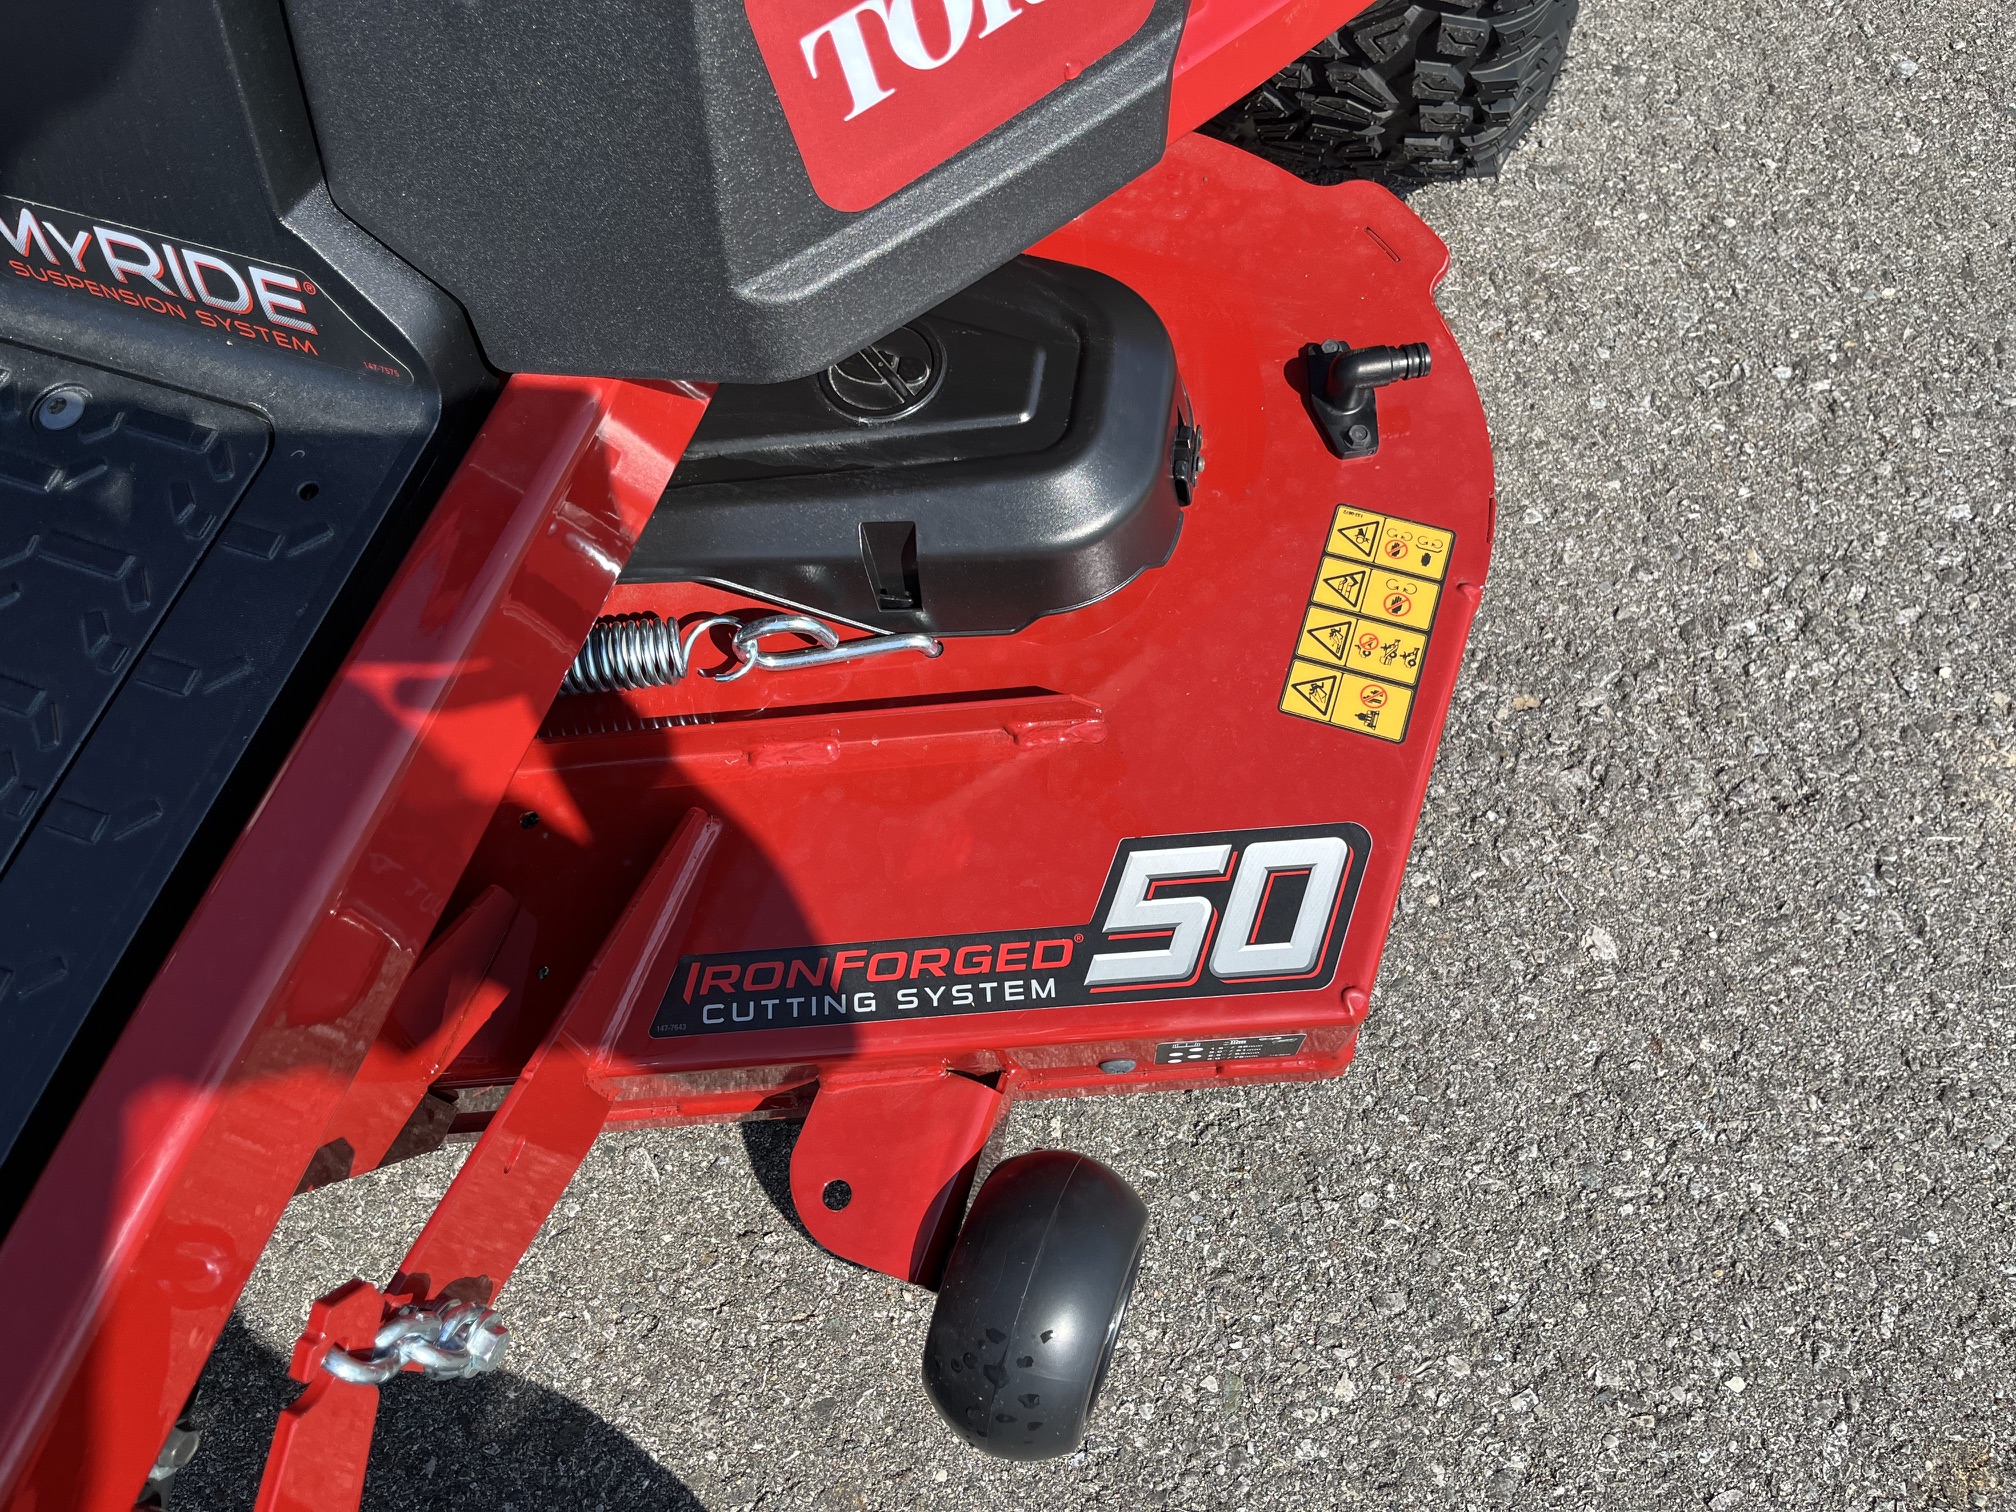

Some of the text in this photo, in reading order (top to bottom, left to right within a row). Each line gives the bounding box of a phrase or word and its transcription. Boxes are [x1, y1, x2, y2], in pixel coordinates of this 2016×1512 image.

[799, 0, 1046, 121] TO
[8, 259, 319, 357] SUSPENSION SYSTEM
[1083, 836, 1354, 994] 50
[702, 978, 1057, 1025] CUTTING SYSTEM
